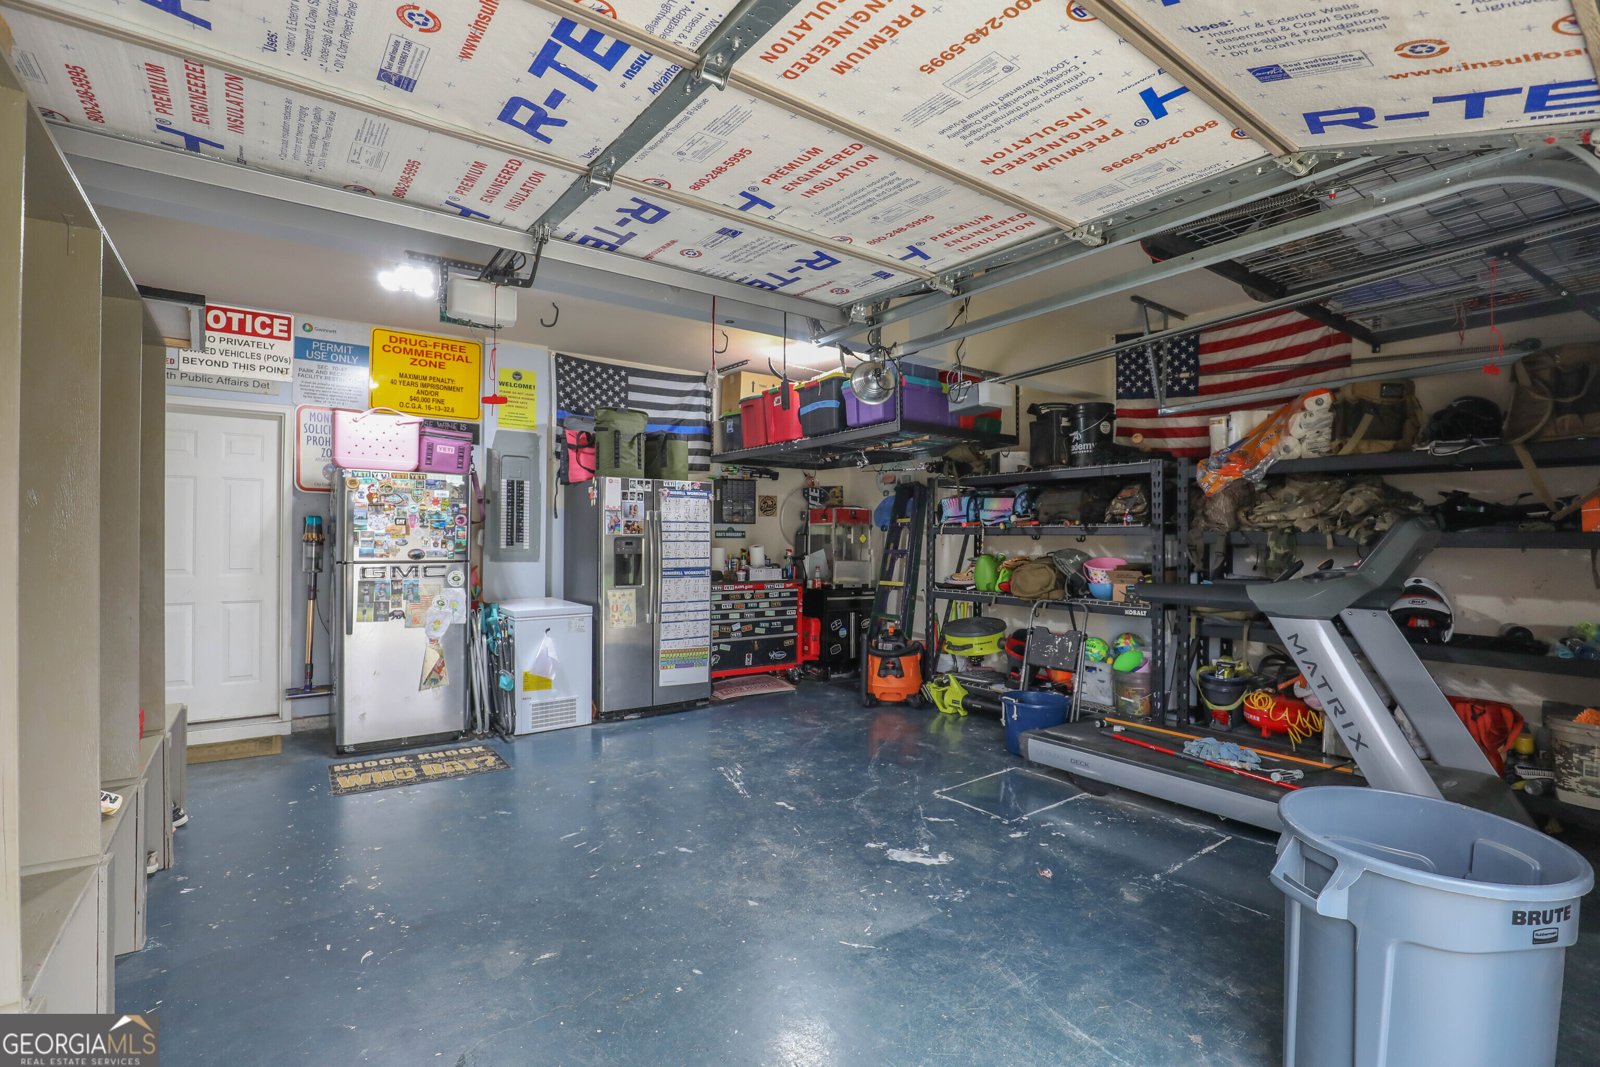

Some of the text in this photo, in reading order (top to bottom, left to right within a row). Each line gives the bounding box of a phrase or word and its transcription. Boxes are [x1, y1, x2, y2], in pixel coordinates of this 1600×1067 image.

[285, 3, 302, 27] Exterior
[643, 0, 678, 35] Lightweig
[659, 5, 691, 40] Adaptable
[683, 11, 706, 35] Insect
[1188, 19, 1234, 34] Uses:
[1208, 25, 1250, 39] Interior
[1267, 11, 1317, 27] Exterior
[1321, 3, 1360, 15] Walls
[1216, 7, 1379, 45] Basement Crawl Space
[262, 30, 281, 53] Uses:
[298, 28, 318, 57] Basement
[689, 18, 719, 49] Moisture
[759, 0, 846, 64] ULATION
[783, 0, 891, 80] NGINEERED
[831, 4, 927, 76] PREMIUM
[919, 0, 1038, 75] 00-248-5995
[1223, 15, 1390, 51] Under-slab Foundations
[1230, 23, 1387, 58] DIY Craft Project Panel
[497, 17, 631, 144] R-TE
[647, 63, 684, 97] Advanta
[1037, 61, 1079, 91] Excellent
[1043, 58, 1070, 78] 100%
[65, 63, 105, 124] 800-248-5995
[145, 62, 174, 117] PREMIUM
[998, 73, 1043, 104] Warranted
[1040, 69, 1086, 100] infiltration
[1045, 73, 1096, 107] Continuous
[224, 72, 245, 135] INSULATION
[966, 99, 998, 122] Thermal
[997, 85, 1039, 114] Versatility
[1023, 95, 1040, 108] and
[1302, 78, 1600, 135] R-TE
[981, 109, 998, 122] and
[992, 104, 1023, 126] thermal
[1004, 101, 1045, 128] insulation
[959, 119, 994, 144] bridging
[964, 140, 975, 150] air
[974, 122, 1005, 145] reduces
[980, 108, 1092, 166] INSULATION
[991, 118, 1109, 175] ENGINEERED
[1032, 128, 1124, 172] PREMIUM
[1102, 120, 1219, 173] 800-248-5995
[392, 159, 421, 199] 800-248-5995
[455, 161, 488, 196] PREMIUM
[480, 158, 523, 204] ENGINEERED
[689, 148, 752, 191] 800-248-5995
[761, 147, 823, 186] PREMIUM
[782, 142, 864, 193] ENGINEERED
[801, 154, 879, 198] INSULATION
[504, 170, 547, 211] INSULATION
[577, 197, 671, 252] R-TE
[930, 214, 993, 242] PREMIUM
[944, 211, 1028, 248] ENGINEERED
[958, 220, 1036, 253] INSULATION
[747, 250, 841, 291] R-TE
[206, 309, 289, 338] OTICE
[219, 337, 276, 351] PRIVATELY
[219, 351, 292, 365] VEHICLES (POVs)
[306, 350, 359, 364] USE ONLY
[312, 341, 354, 354] PERMIT
[382, 345, 473, 364] COMMERCIAL
[389, 335, 467, 354] DRUG-FREE
[182, 356, 290, 376] BEYOND THIS POINT
[398, 372, 456, 385] MAXIMUM PENALTY:
[409, 358, 446, 370] ZONE
[180, 372, 213, 384] Public
[216, 376, 249, 388] Affairs
[252, 380, 270, 390] Det
[390, 378, 464, 393] 40 YEARS IMPRISONMENT
[416, 389, 439, 397] AND/OR
[498, 380, 536, 390] WELCOME!
[309, 411, 331, 423] MON
[399, 402, 424, 411] O.C.G.A.
[303, 423, 331, 435] SOLICI
[306, 436, 331, 447] PROH
[321, 448, 333, 458] ZO
[360, 565, 447, 579] GMC
[1124, 609, 1147, 617] KOBALT
[1287, 633, 1369, 752] MATRIX
[418, 746, 486, 760] KNOCK
[1070, 758, 1091, 768] DECK
[336, 755, 496, 789] WHO DAT?
[1511, 904, 1571, 926] BRUTE
